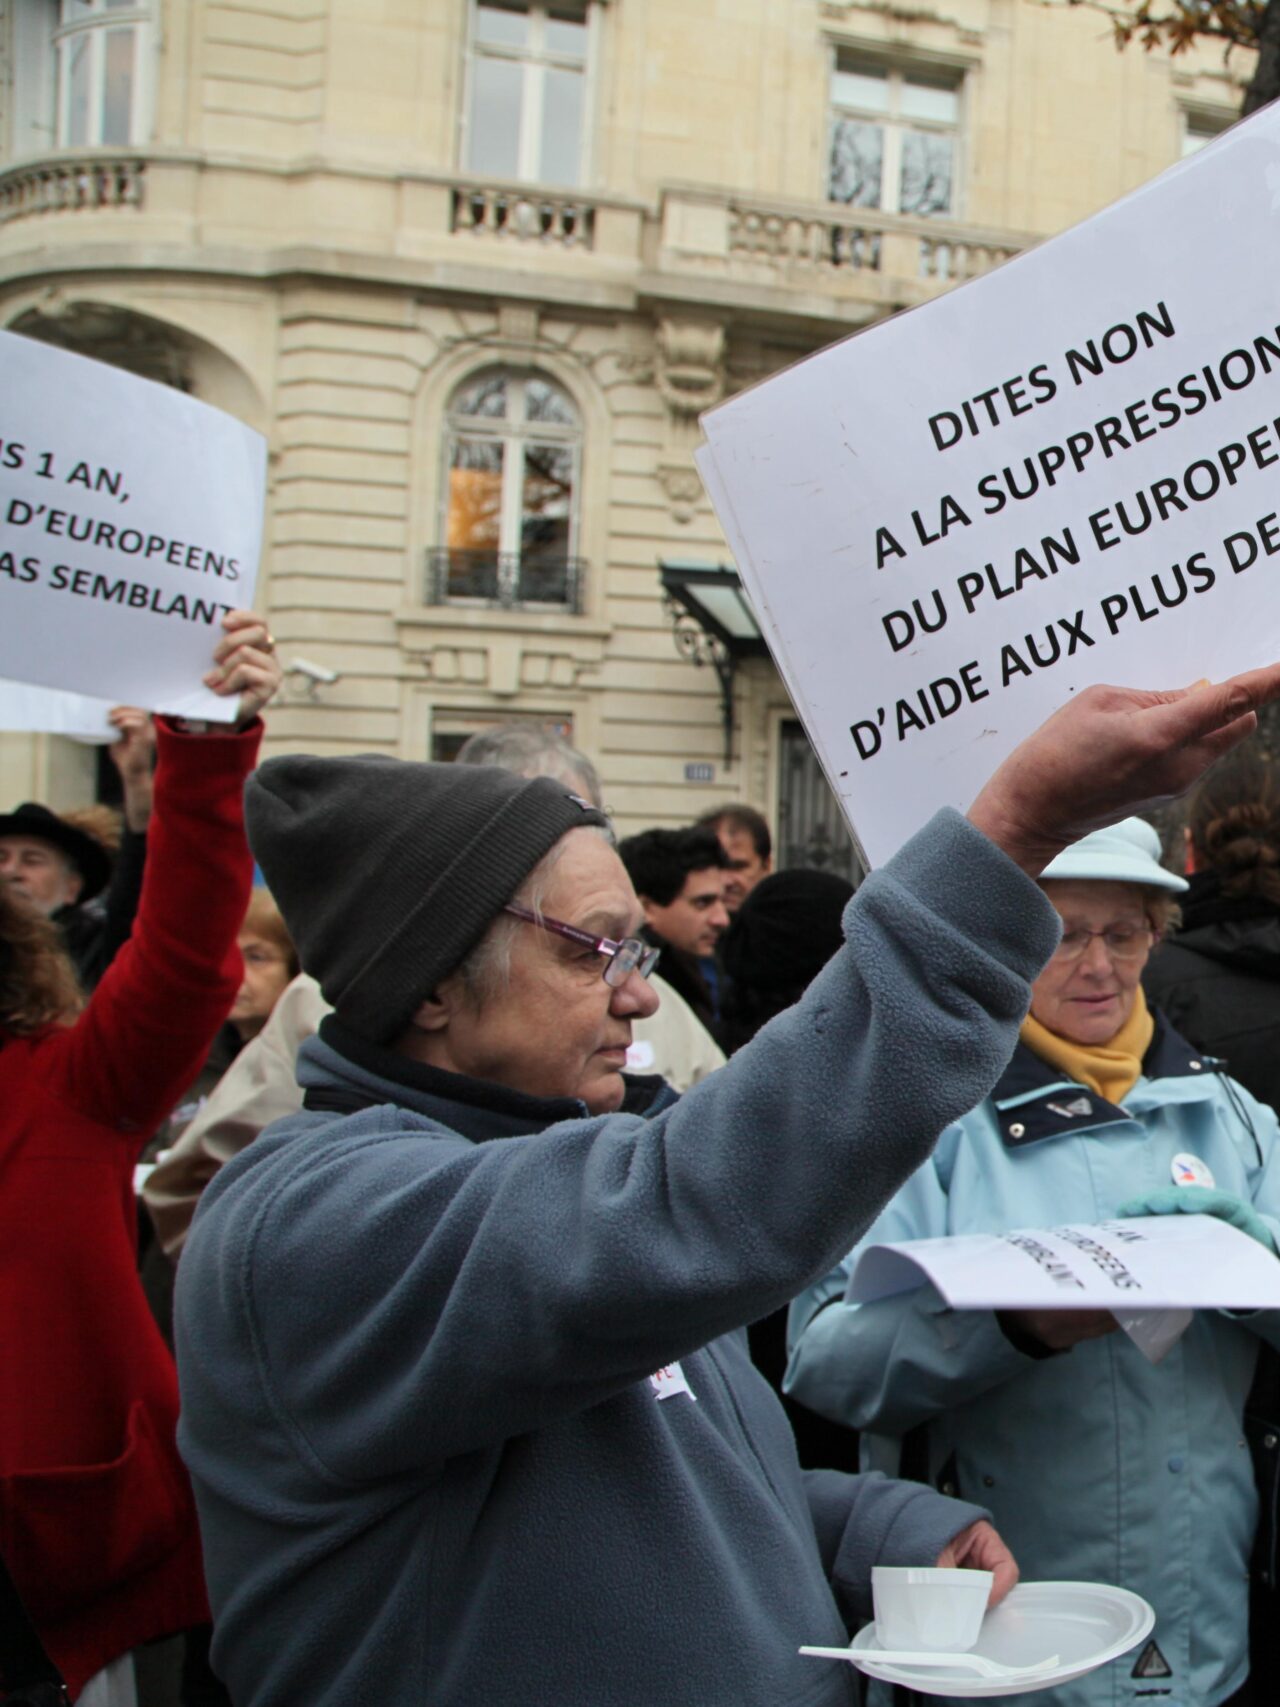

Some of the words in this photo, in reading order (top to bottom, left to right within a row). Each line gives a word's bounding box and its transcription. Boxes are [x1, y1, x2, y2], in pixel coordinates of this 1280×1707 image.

[928, 364, 1056, 451] DITES
[1065, 301, 1175, 385] NON
[0, 438, 26, 469] S
[35, 452, 54, 478] 1
[65, 461, 130, 504] AN,
[6, 498, 240, 580] D’EUROPEENS
[876, 527, 907, 570] A
[911, 495, 972, 546] LA
[882, 589, 947, 652] DU
[957, 527, 1080, 614] PLAN
[850, 661, 989, 760] D’AIDE
[1001, 610, 1095, 687] AUX
[1101, 552, 1215, 635] PLUS
